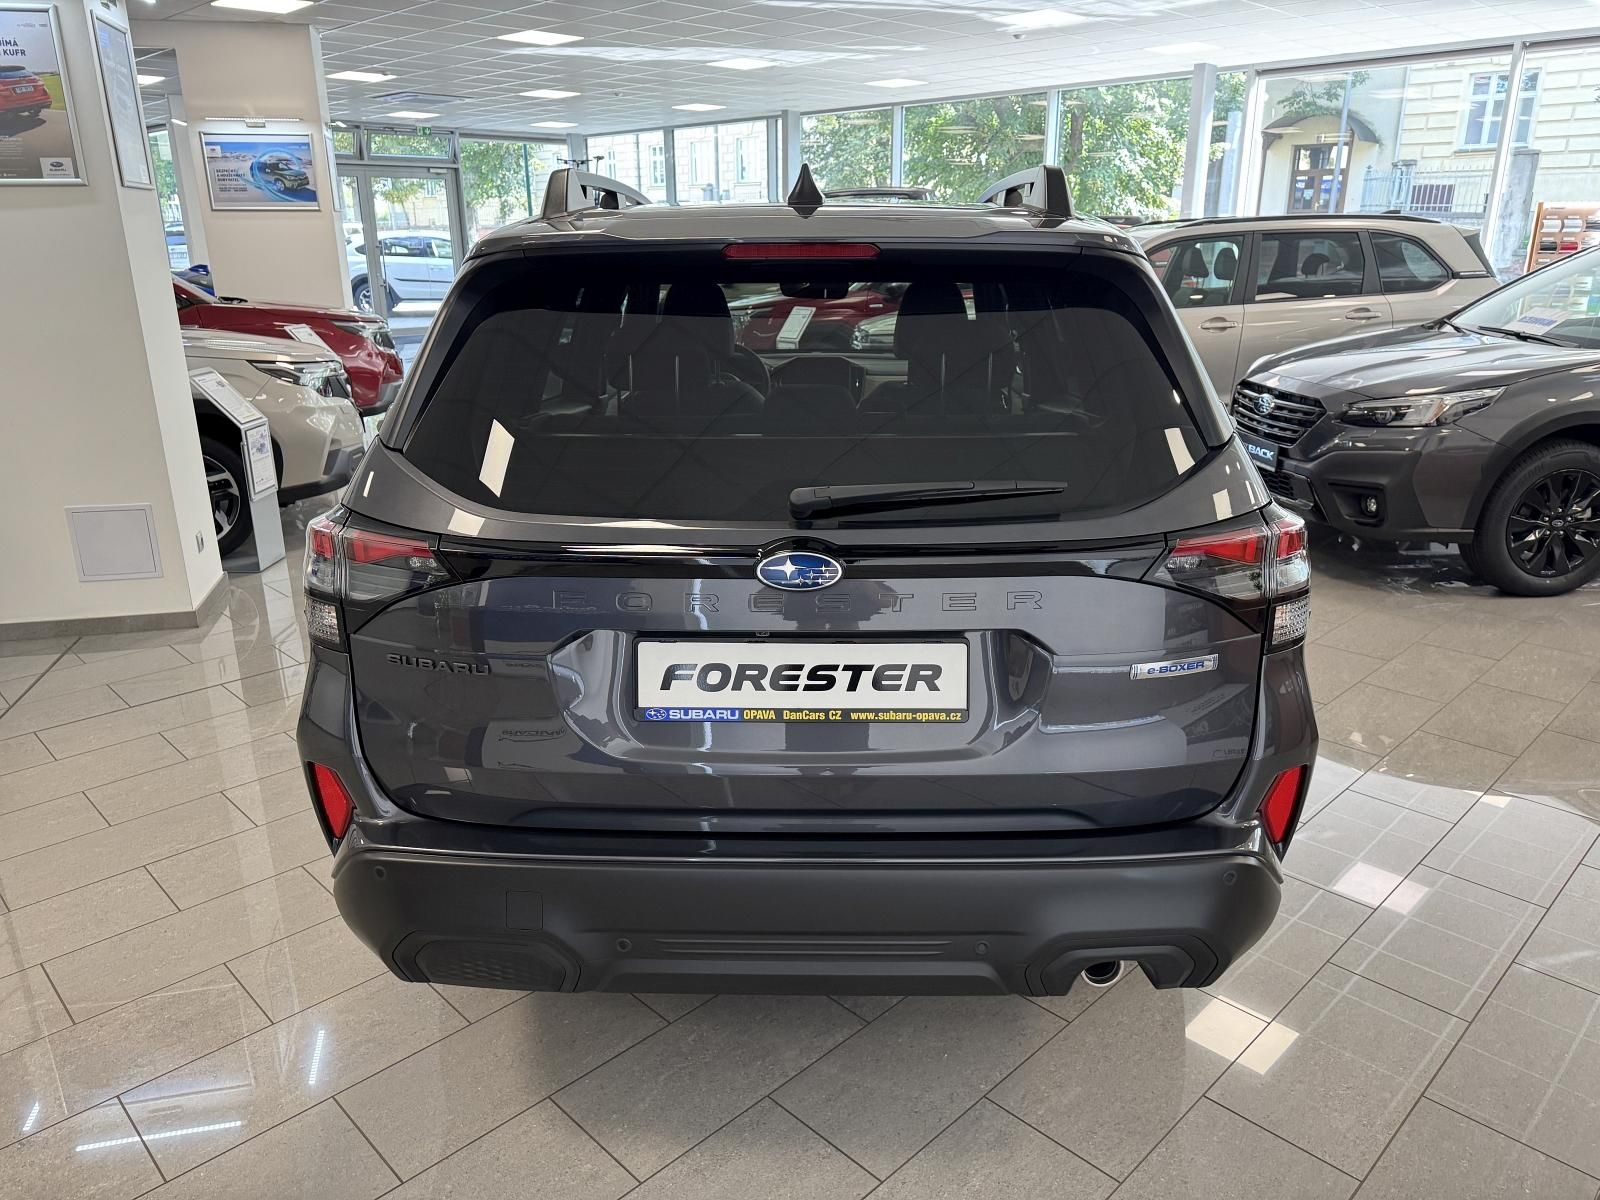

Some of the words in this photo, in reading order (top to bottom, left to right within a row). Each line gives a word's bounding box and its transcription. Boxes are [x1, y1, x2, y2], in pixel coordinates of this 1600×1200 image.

[3, 48, 26, 56] KUFR
[1247, 444, 1275, 460] BACK
[552, 590, 1043, 613] FORESTER
[386, 653, 490, 676] SUBARU
[1147, 660, 1205, 675] e-BOXER
[660, 663, 943, 692] FORESTER
[669, 709, 739, 720] SUBARU
[743, 710, 776, 720] OPAVA
[783, 710, 826, 720] DanCars
[828, 710, 842, 720] CZ
[850, 710, 962, 722] www.subaru-opava.cz
